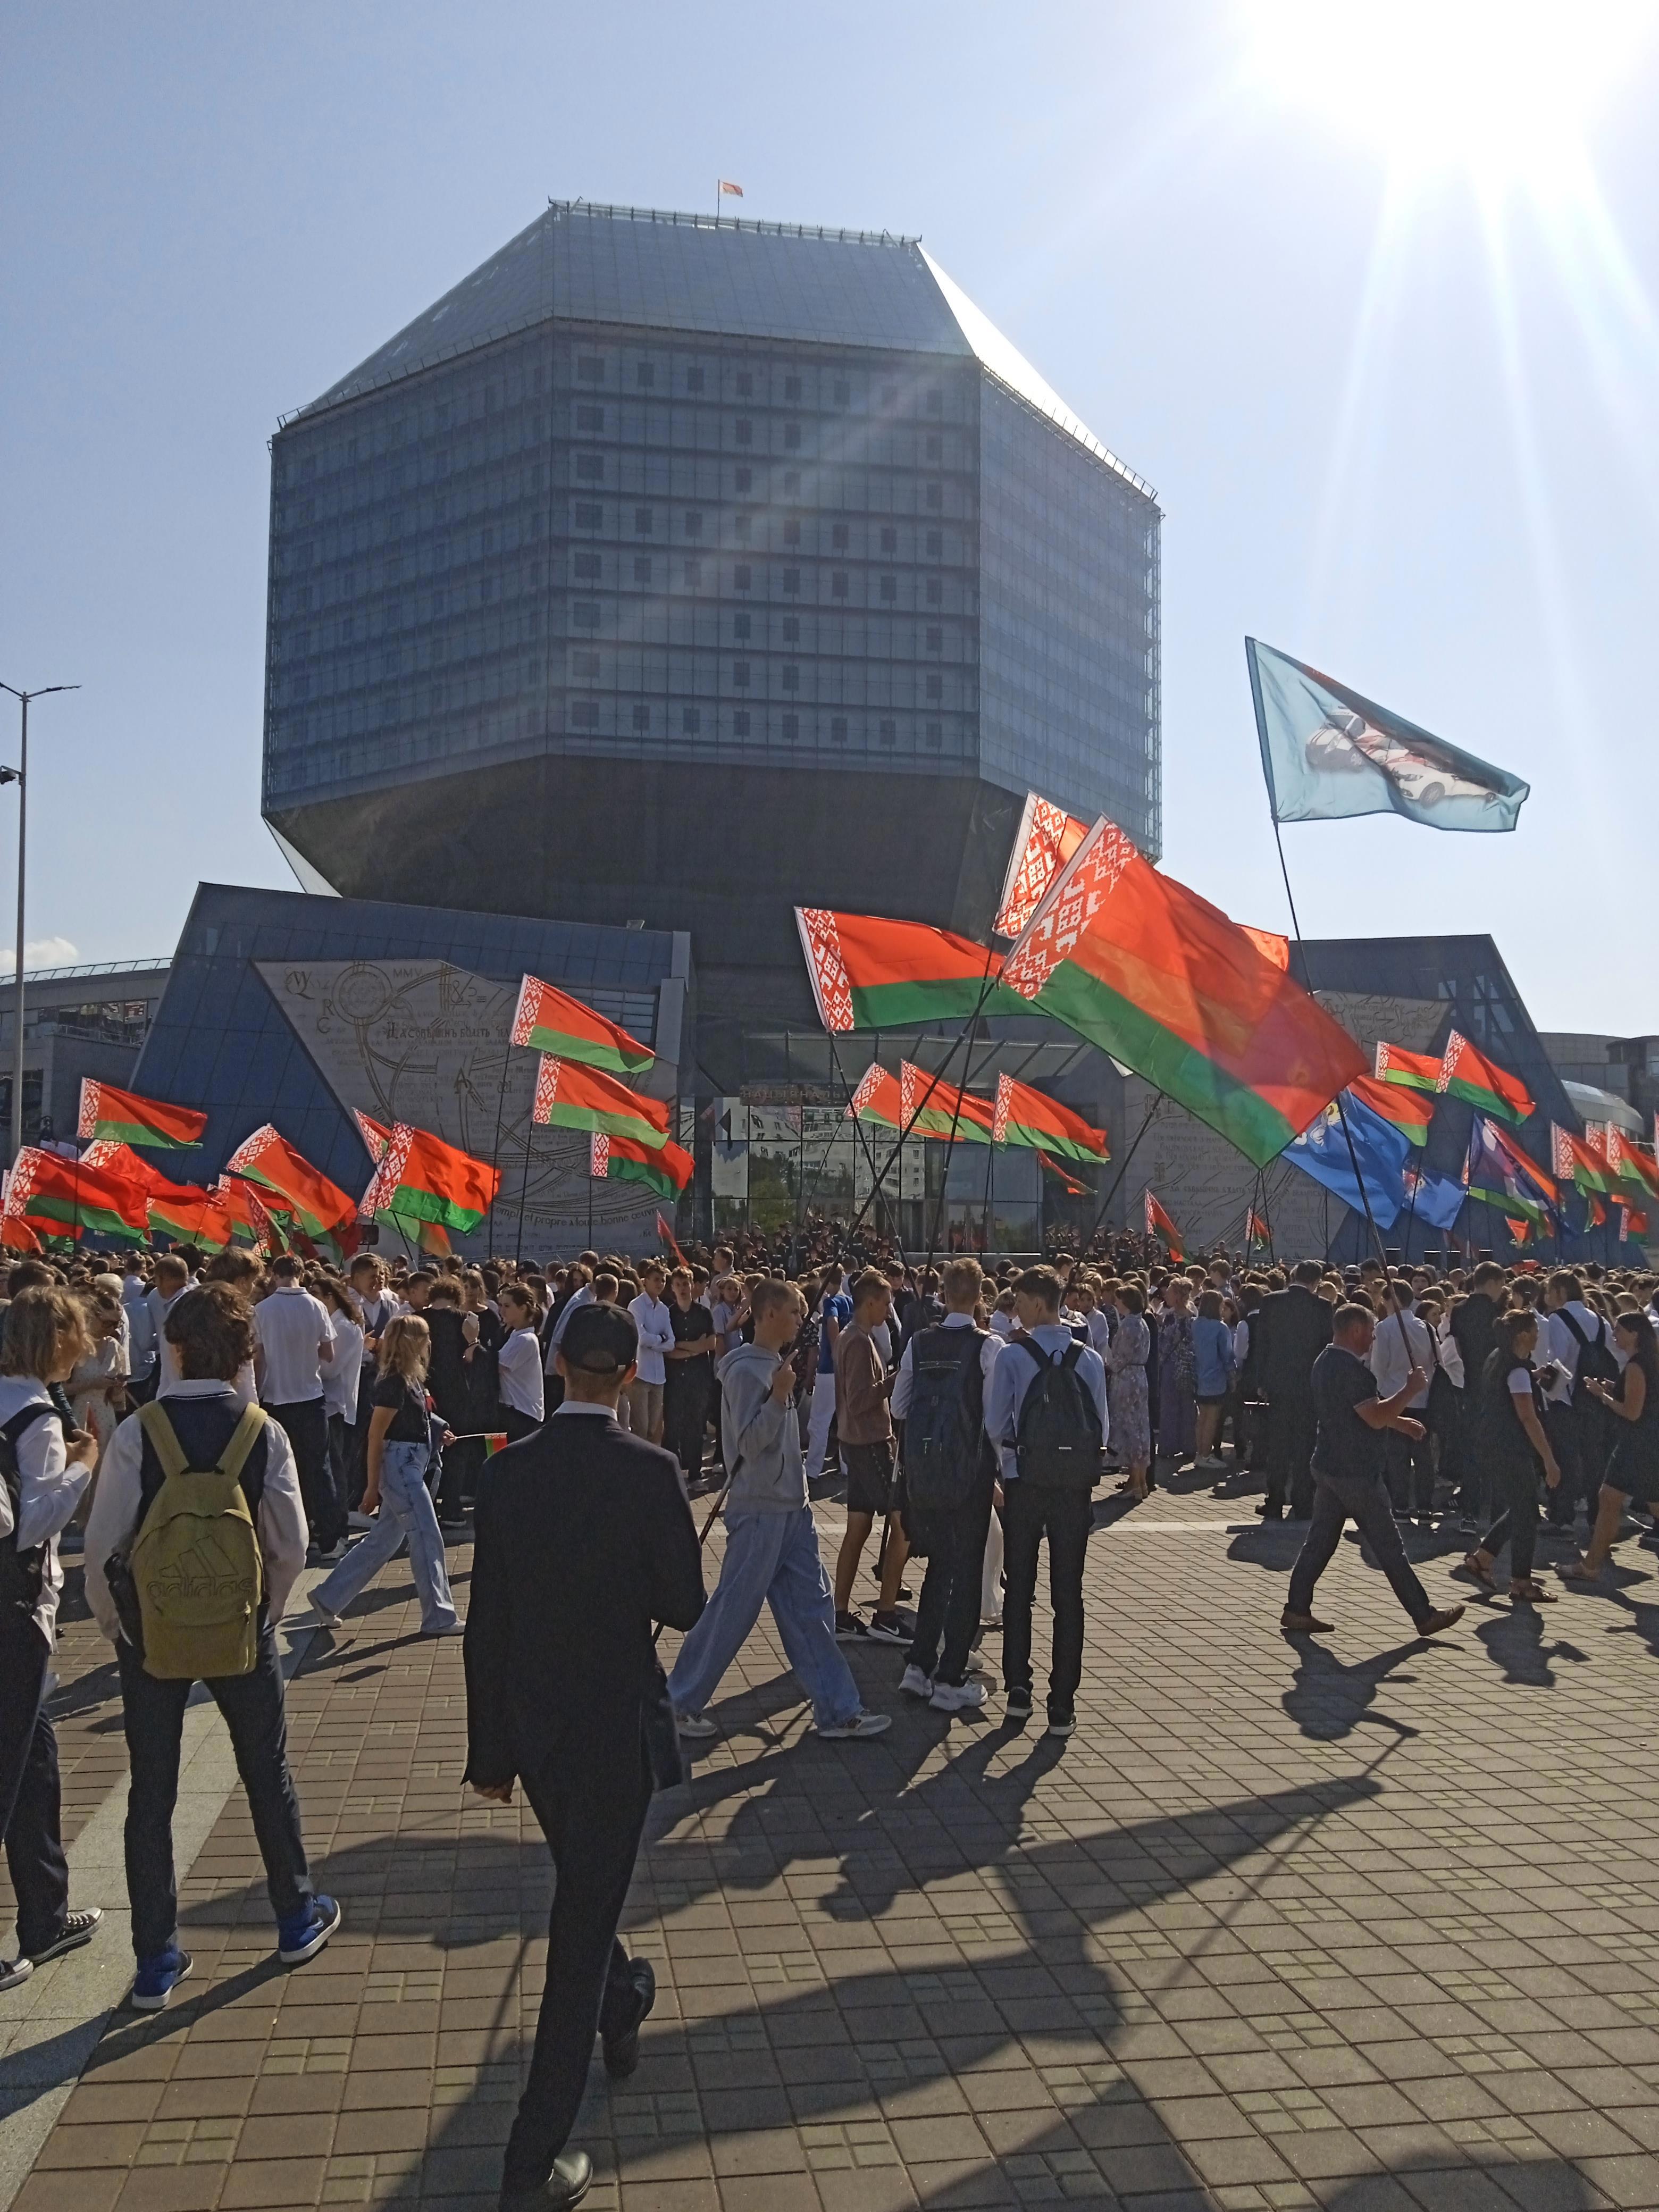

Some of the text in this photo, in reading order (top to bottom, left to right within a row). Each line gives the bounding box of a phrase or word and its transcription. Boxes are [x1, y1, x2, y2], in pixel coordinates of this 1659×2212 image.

[535, 1216, 567, 1228] propre
[601, 1216, 629, 1225] bonne
[146, 1576, 255, 1598] adidas
